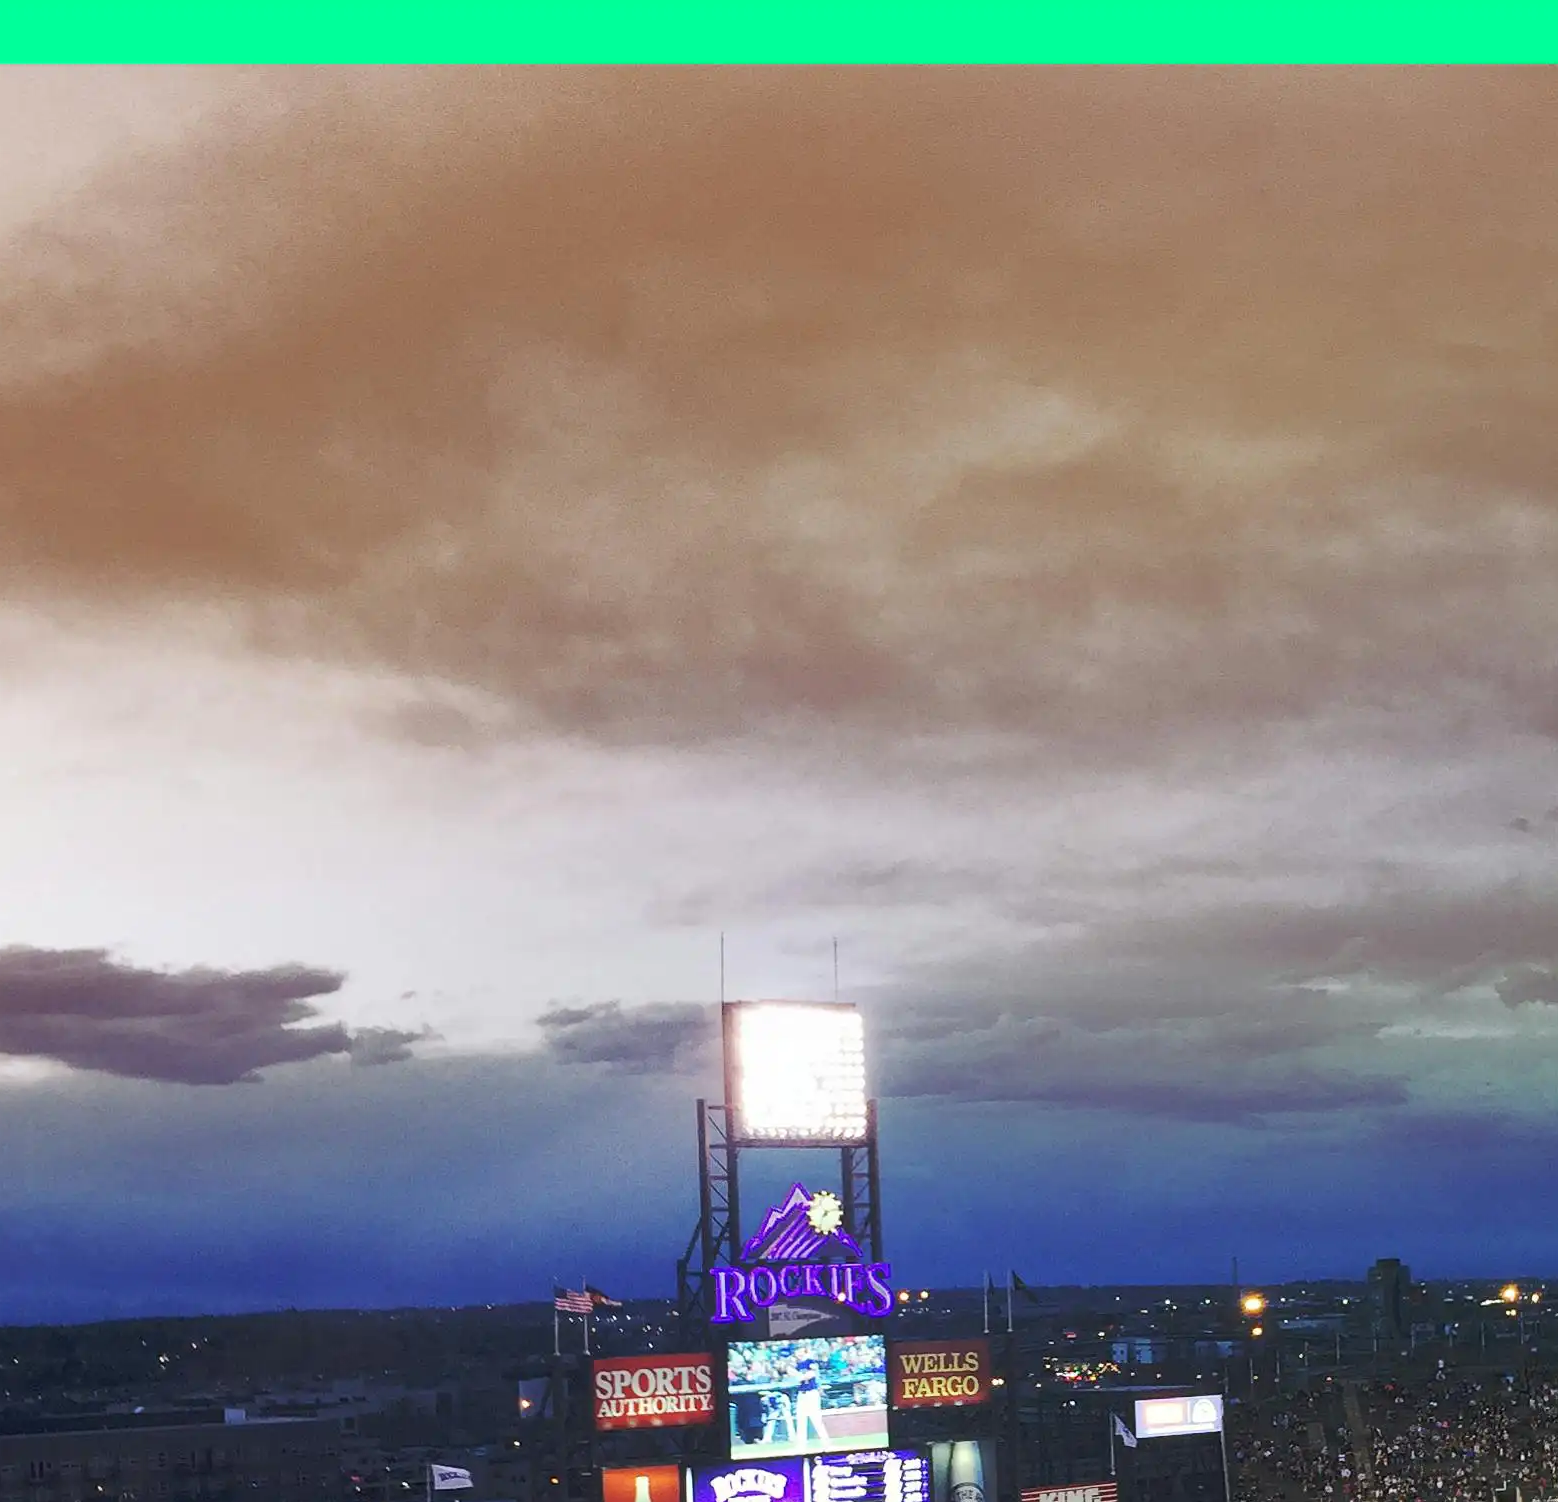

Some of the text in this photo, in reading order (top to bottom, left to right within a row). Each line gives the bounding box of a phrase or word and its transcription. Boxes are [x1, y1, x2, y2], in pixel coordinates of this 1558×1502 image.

[710, 1263, 894, 1323] ROCKIES
[899, 1352, 979, 1374] WELLS
[595, 1365, 712, 1399] SPORTS
[902, 1375, 979, 1398] FARGO
